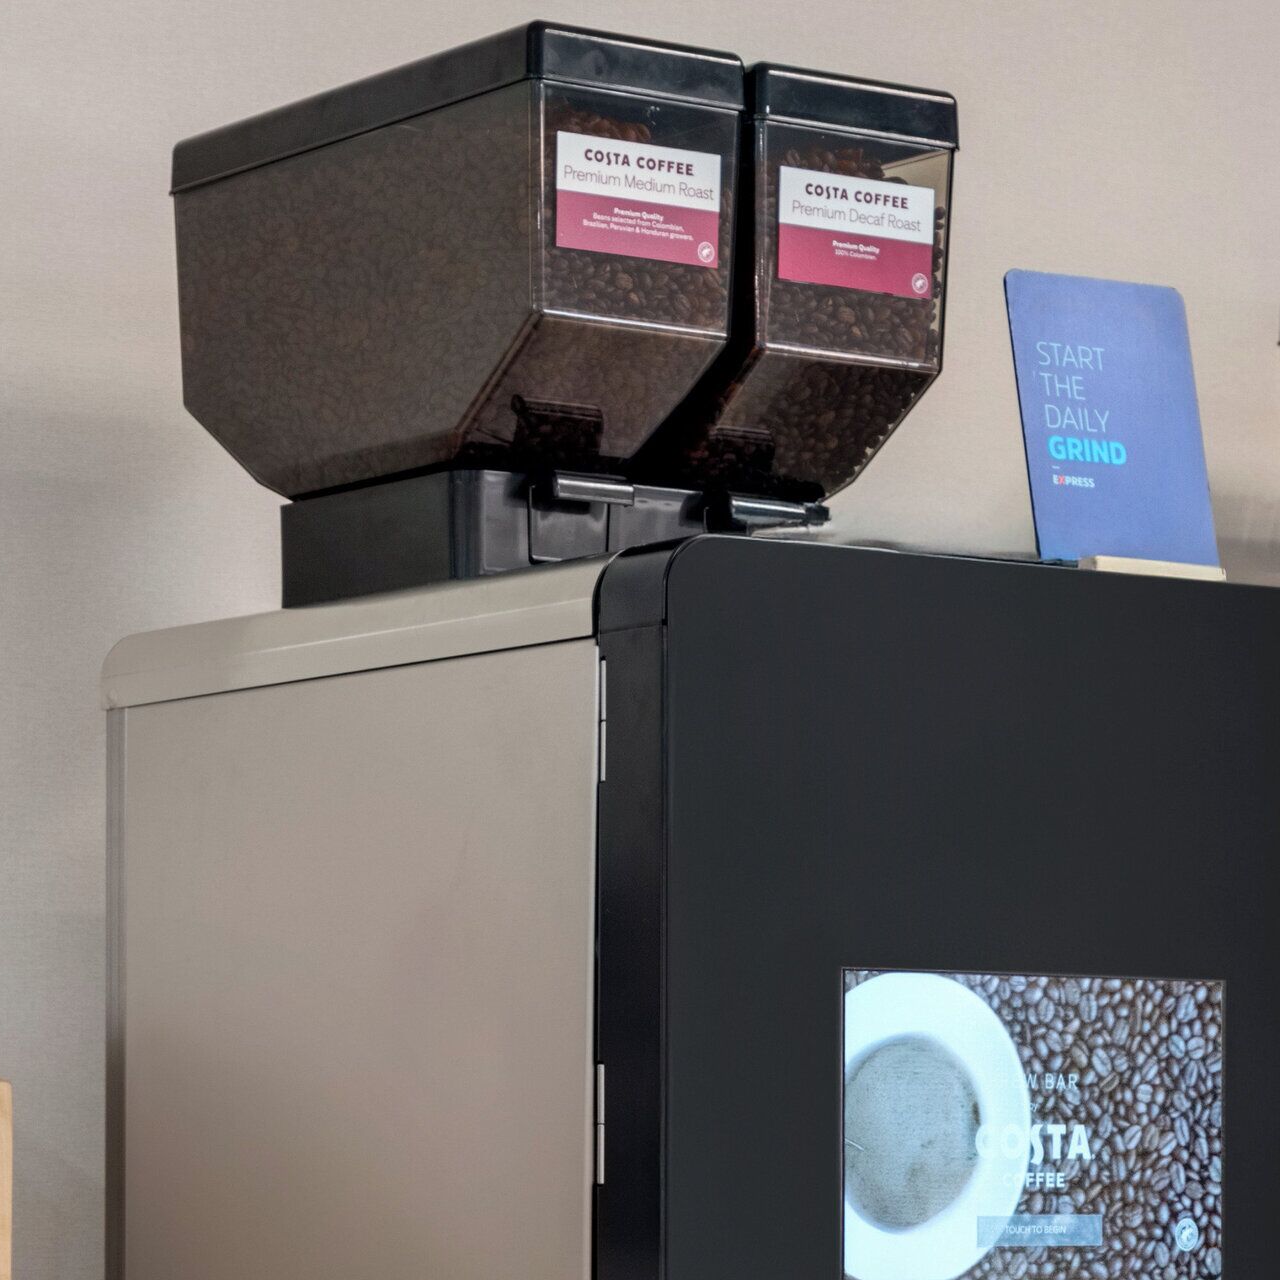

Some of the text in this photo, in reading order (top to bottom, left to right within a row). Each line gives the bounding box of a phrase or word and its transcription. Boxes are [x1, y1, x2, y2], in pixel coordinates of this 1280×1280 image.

[584, 149, 695, 177] COSTA COFFEE
[563, 165, 715, 201] Premium Medium Roast
[804, 183, 909, 210] COSTA COFFEE
[592, 212, 611, 221] Beans
[611, 215, 636, 225] selected
[637, 218, 651, 226] from
[613, 207, 665, 222] Premium Quality
[791, 199, 922, 233] Premium Decaf Roast
[832, 240, 880, 254] Premium Quality
[1036, 341, 1106, 372] START
[1039, 371, 1086, 401] THE
[1044, 403, 1110, 434] DAILY
[1047, 434, 1128, 466] GRIND
[1052, 474, 1096, 489] EXPRESS
[1044, 1073, 1079, 1090] BAR
[975, 1123, 1093, 1166] COSTA
[1004, 1172, 1066, 1188] COFFEE
[1004, 1225, 1067, 1235] TOUCH TO BEGIN
